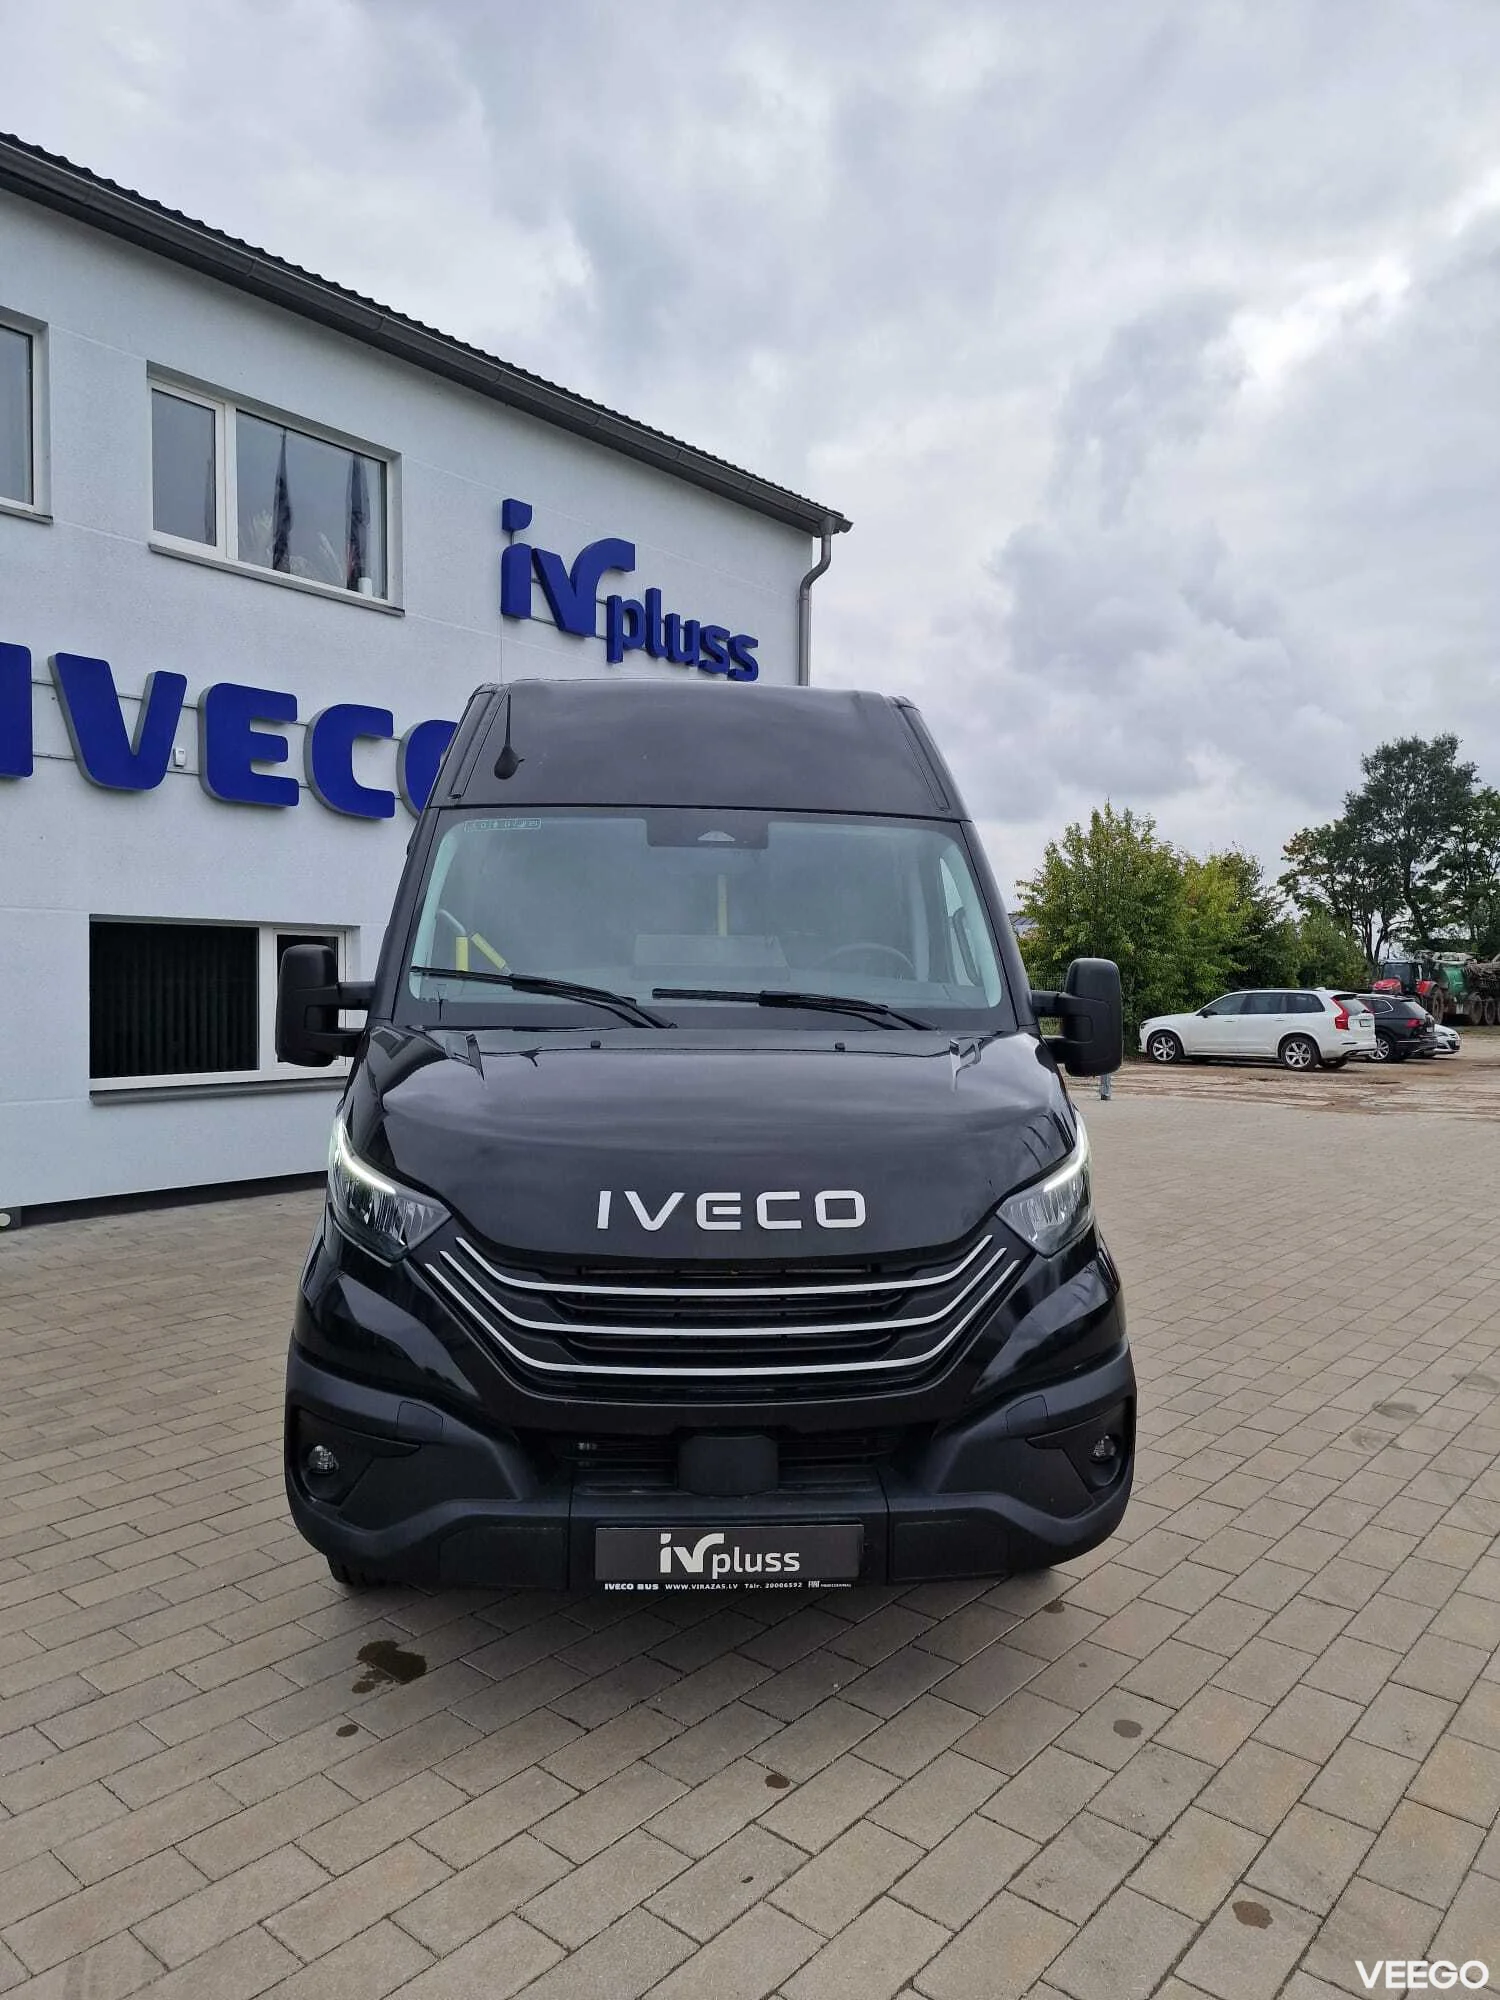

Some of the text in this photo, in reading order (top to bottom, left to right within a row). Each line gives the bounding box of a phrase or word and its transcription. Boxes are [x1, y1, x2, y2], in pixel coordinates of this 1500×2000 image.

[606, 587, 759, 682] pluss
[597, 1190, 866, 1231] IVECO
[712, 1546, 800, 1579] pluss
